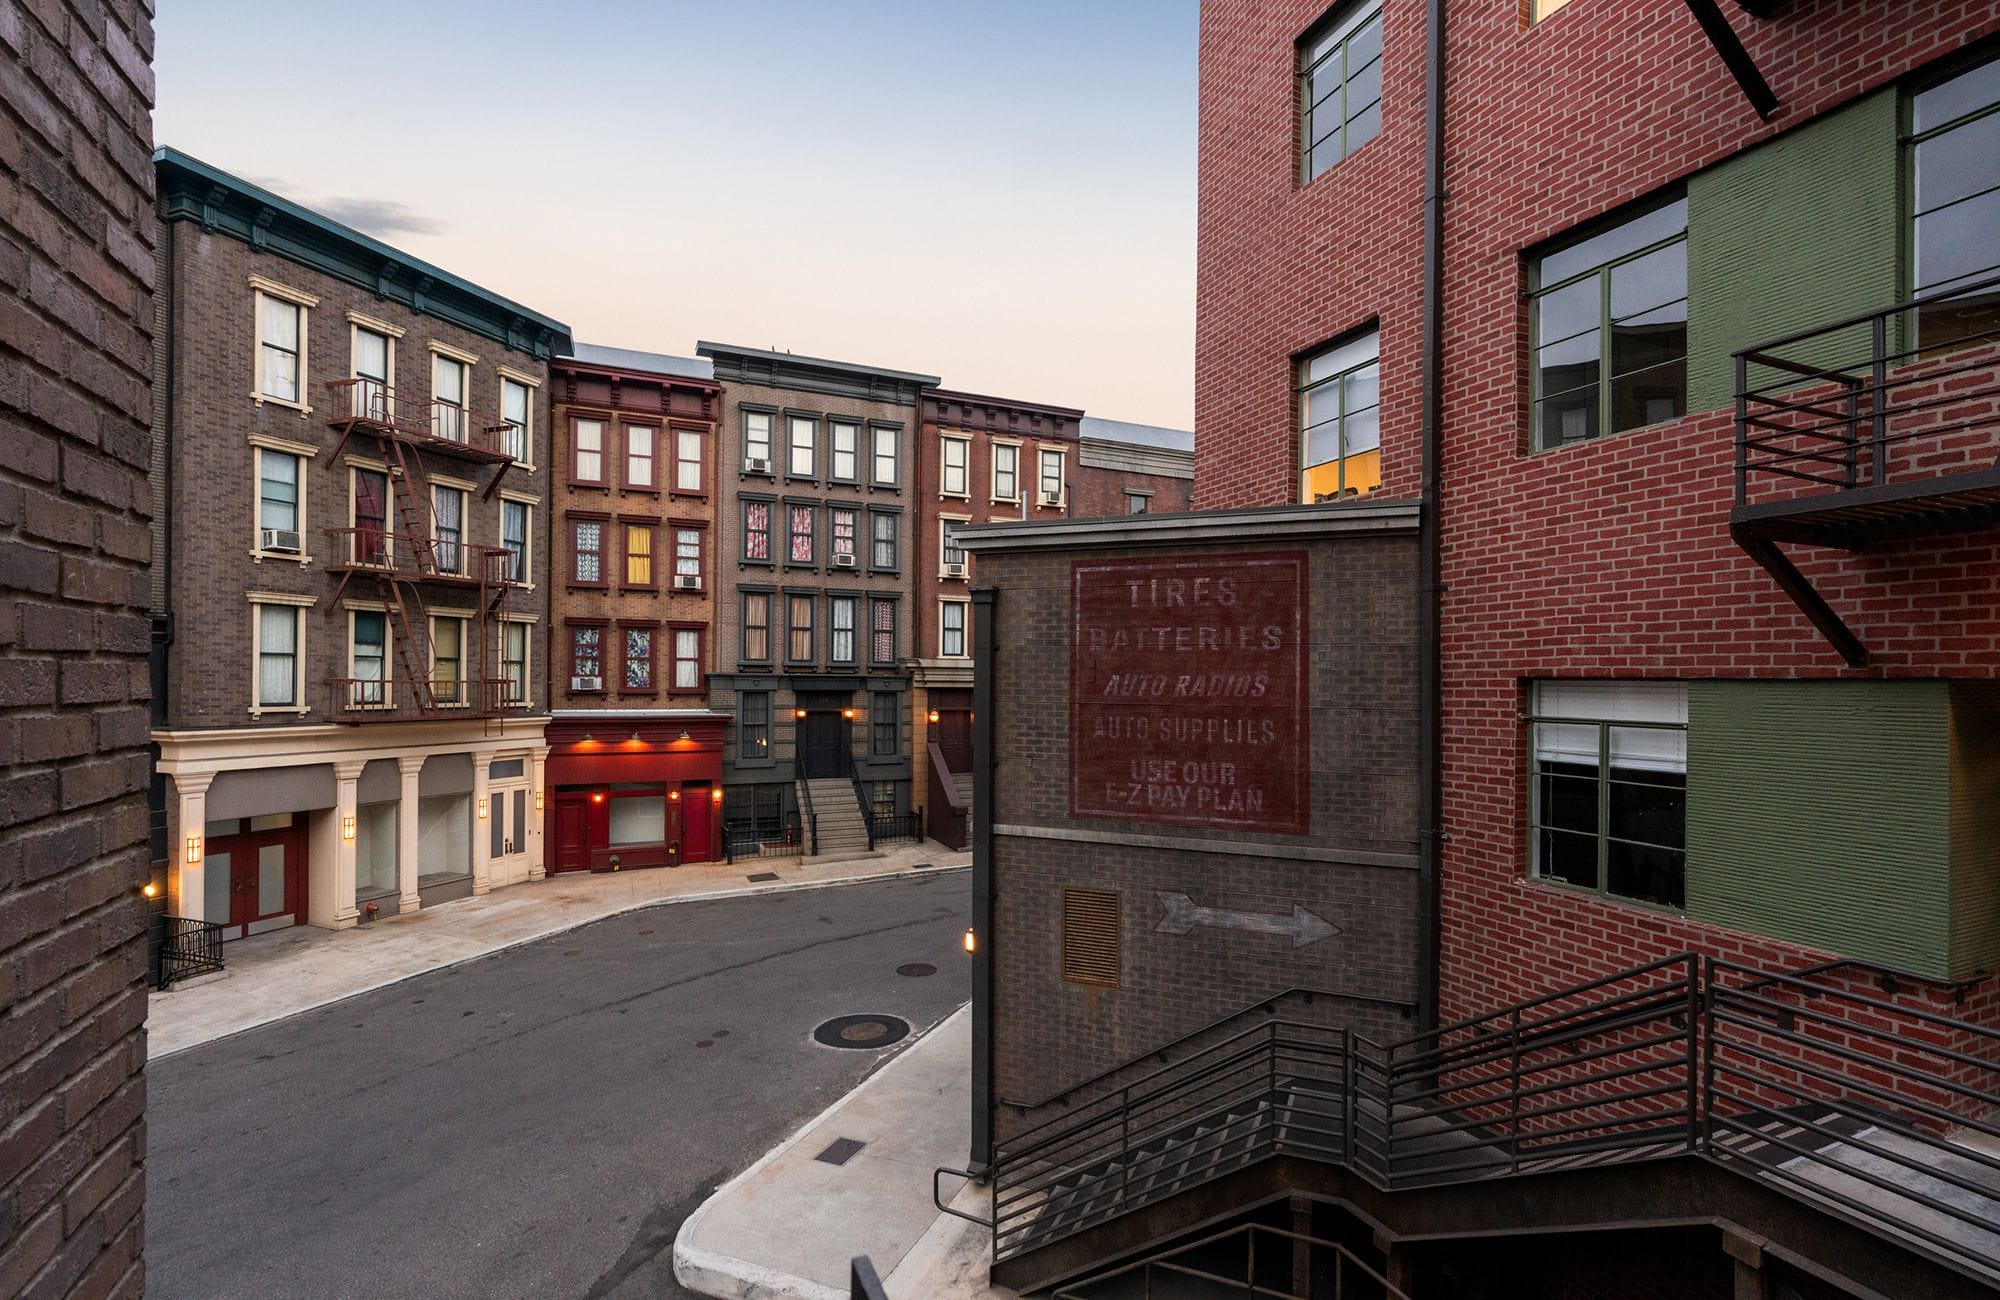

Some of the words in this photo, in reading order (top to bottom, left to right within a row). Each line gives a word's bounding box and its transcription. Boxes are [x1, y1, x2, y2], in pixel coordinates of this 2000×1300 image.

[1126, 577, 1237, 608] TIRES
[1089, 624, 1282, 651] BATTERIES
[1102, 673, 1168, 697] AUTO
[1173, 673, 1269, 697] RADIOS
[1093, 715, 1149, 740] AUTO
[1159, 717, 1276, 744] SUPPLIES
[1130, 758, 1177, 783] USE
[1182, 761, 1237, 785] OUR
[1105, 781, 1142, 806] E-Z
[1147, 784, 1192, 808] PAY
[1197, 785, 1264, 811] PLAN
